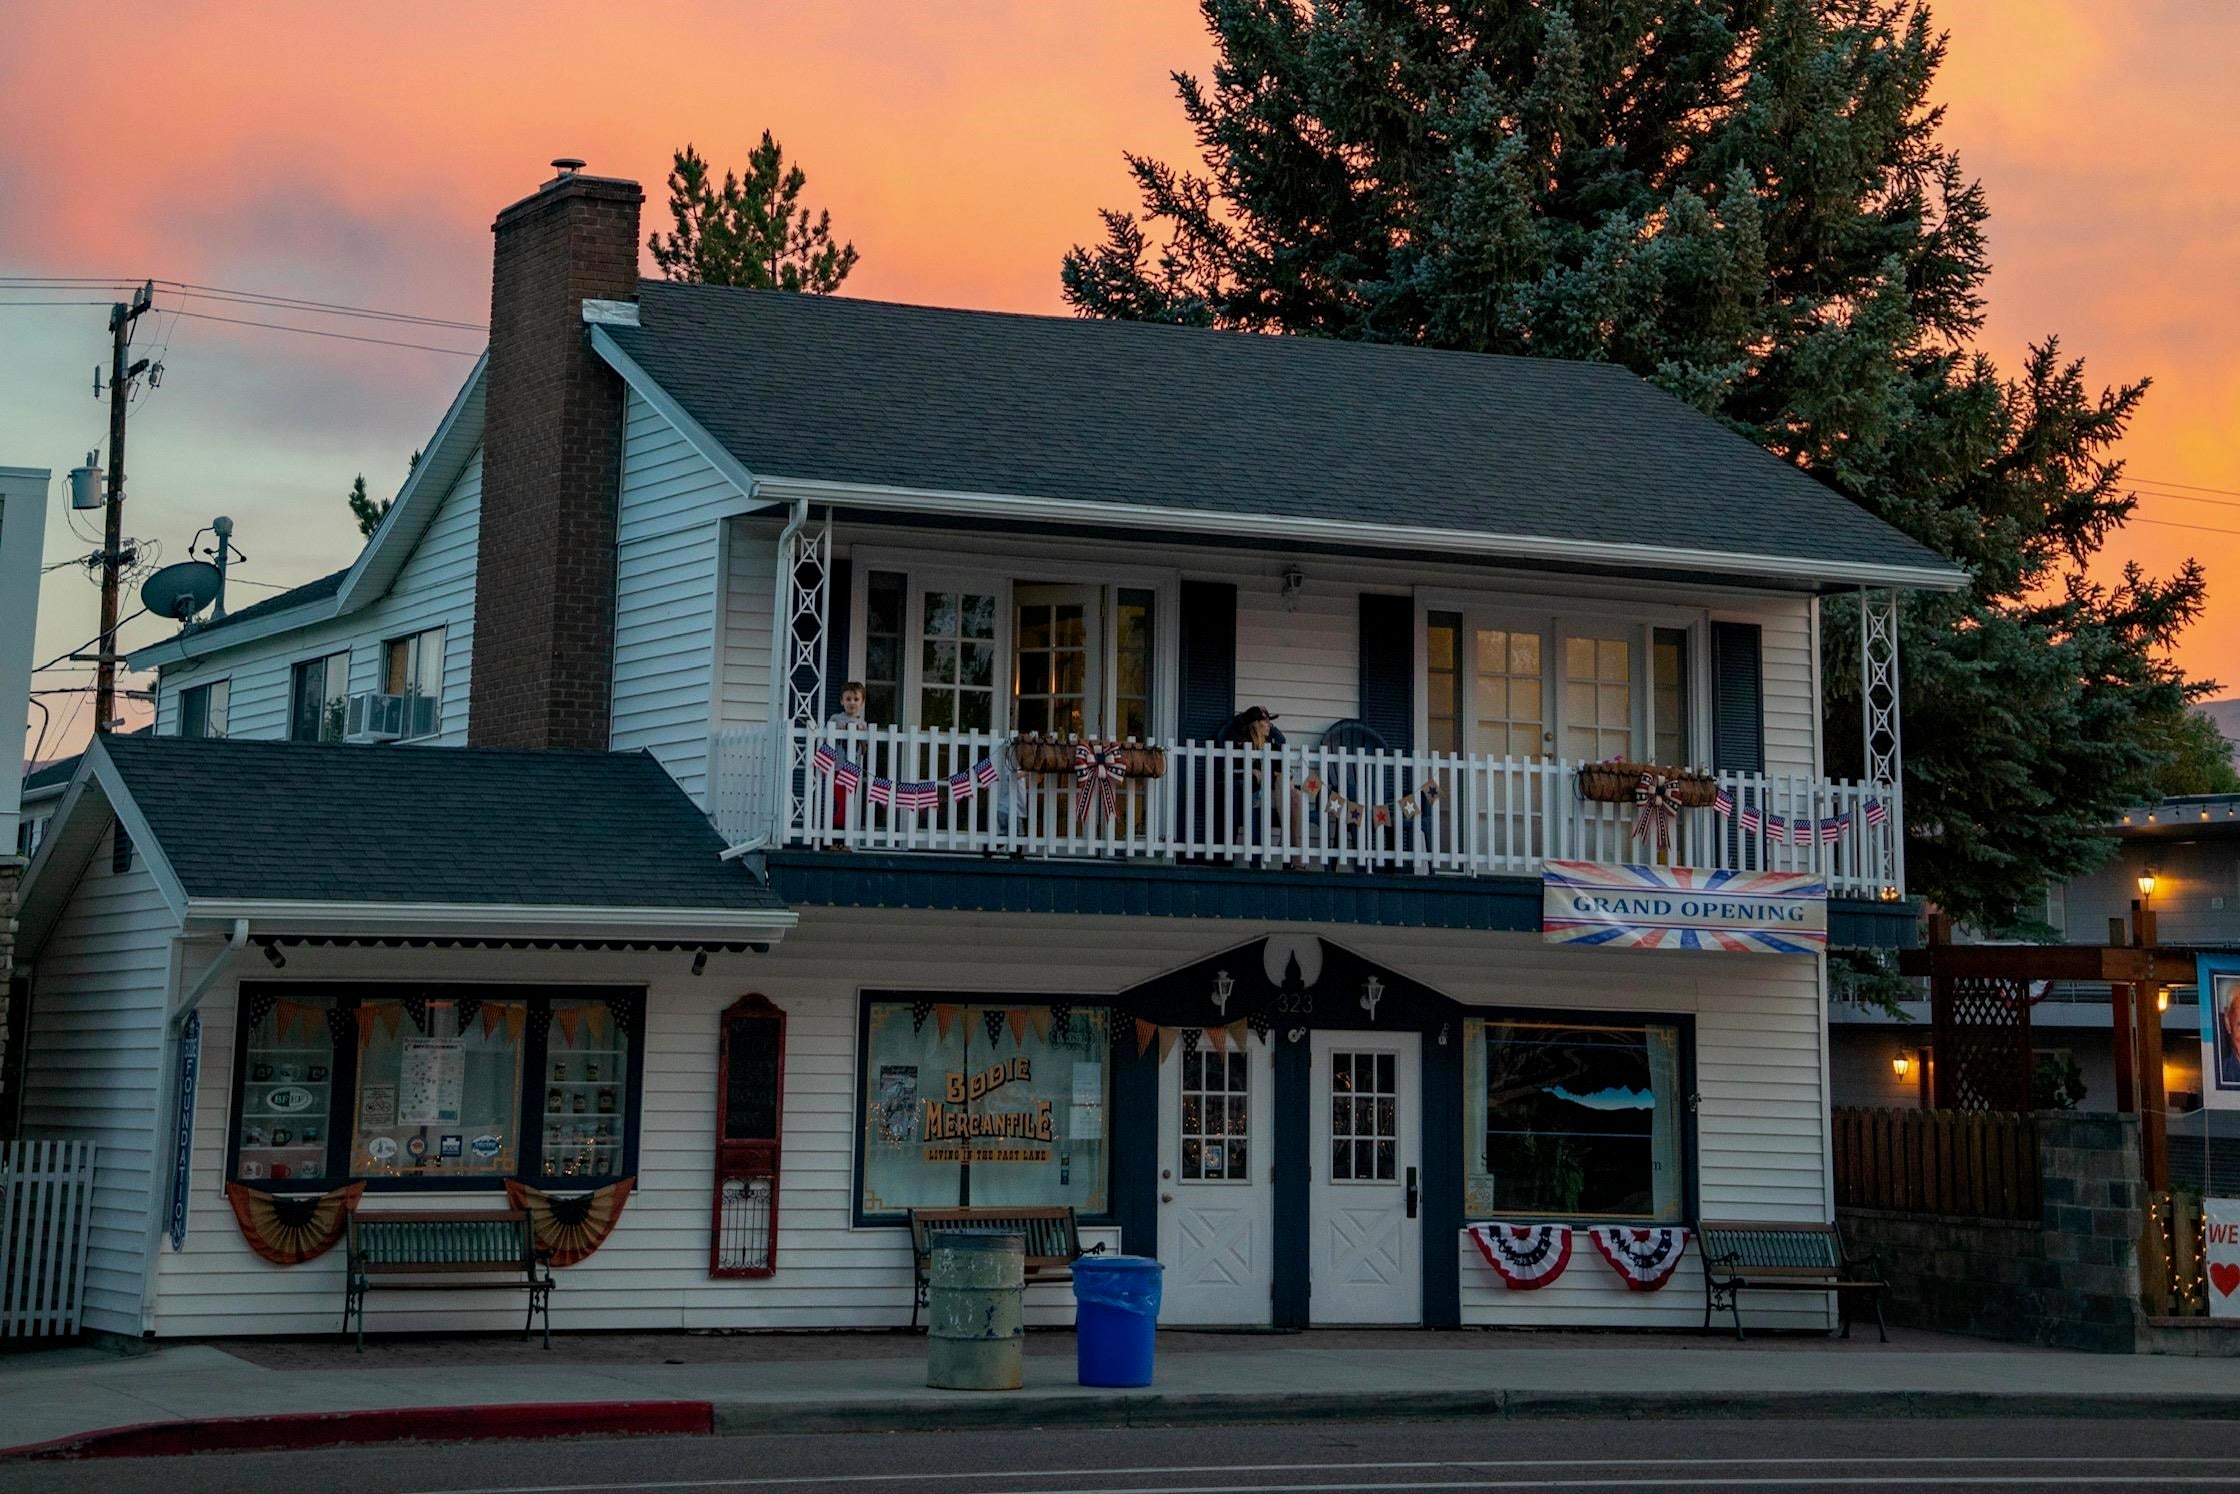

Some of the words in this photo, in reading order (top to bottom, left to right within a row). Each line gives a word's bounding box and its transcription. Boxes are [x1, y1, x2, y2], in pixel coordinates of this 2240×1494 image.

[1573, 896, 1672, 916] GRAND
[1681, 900, 1805, 922] OPENING
[1278, 992, 1313, 1014] 323
[945, 1056, 1031, 1104] BODIE
[924, 1100, 1052, 1142] MERCANTILE
[173, 1059, 193, 1238] FOUNDATION
[929, 1150, 959, 1161] LIVING
[963, 1150, 972, 1161] IN
[977, 1150, 993, 1161] THE
[1023, 1150, 1046, 1161] LANE
[2208, 1223, 2239, 1244] WE
